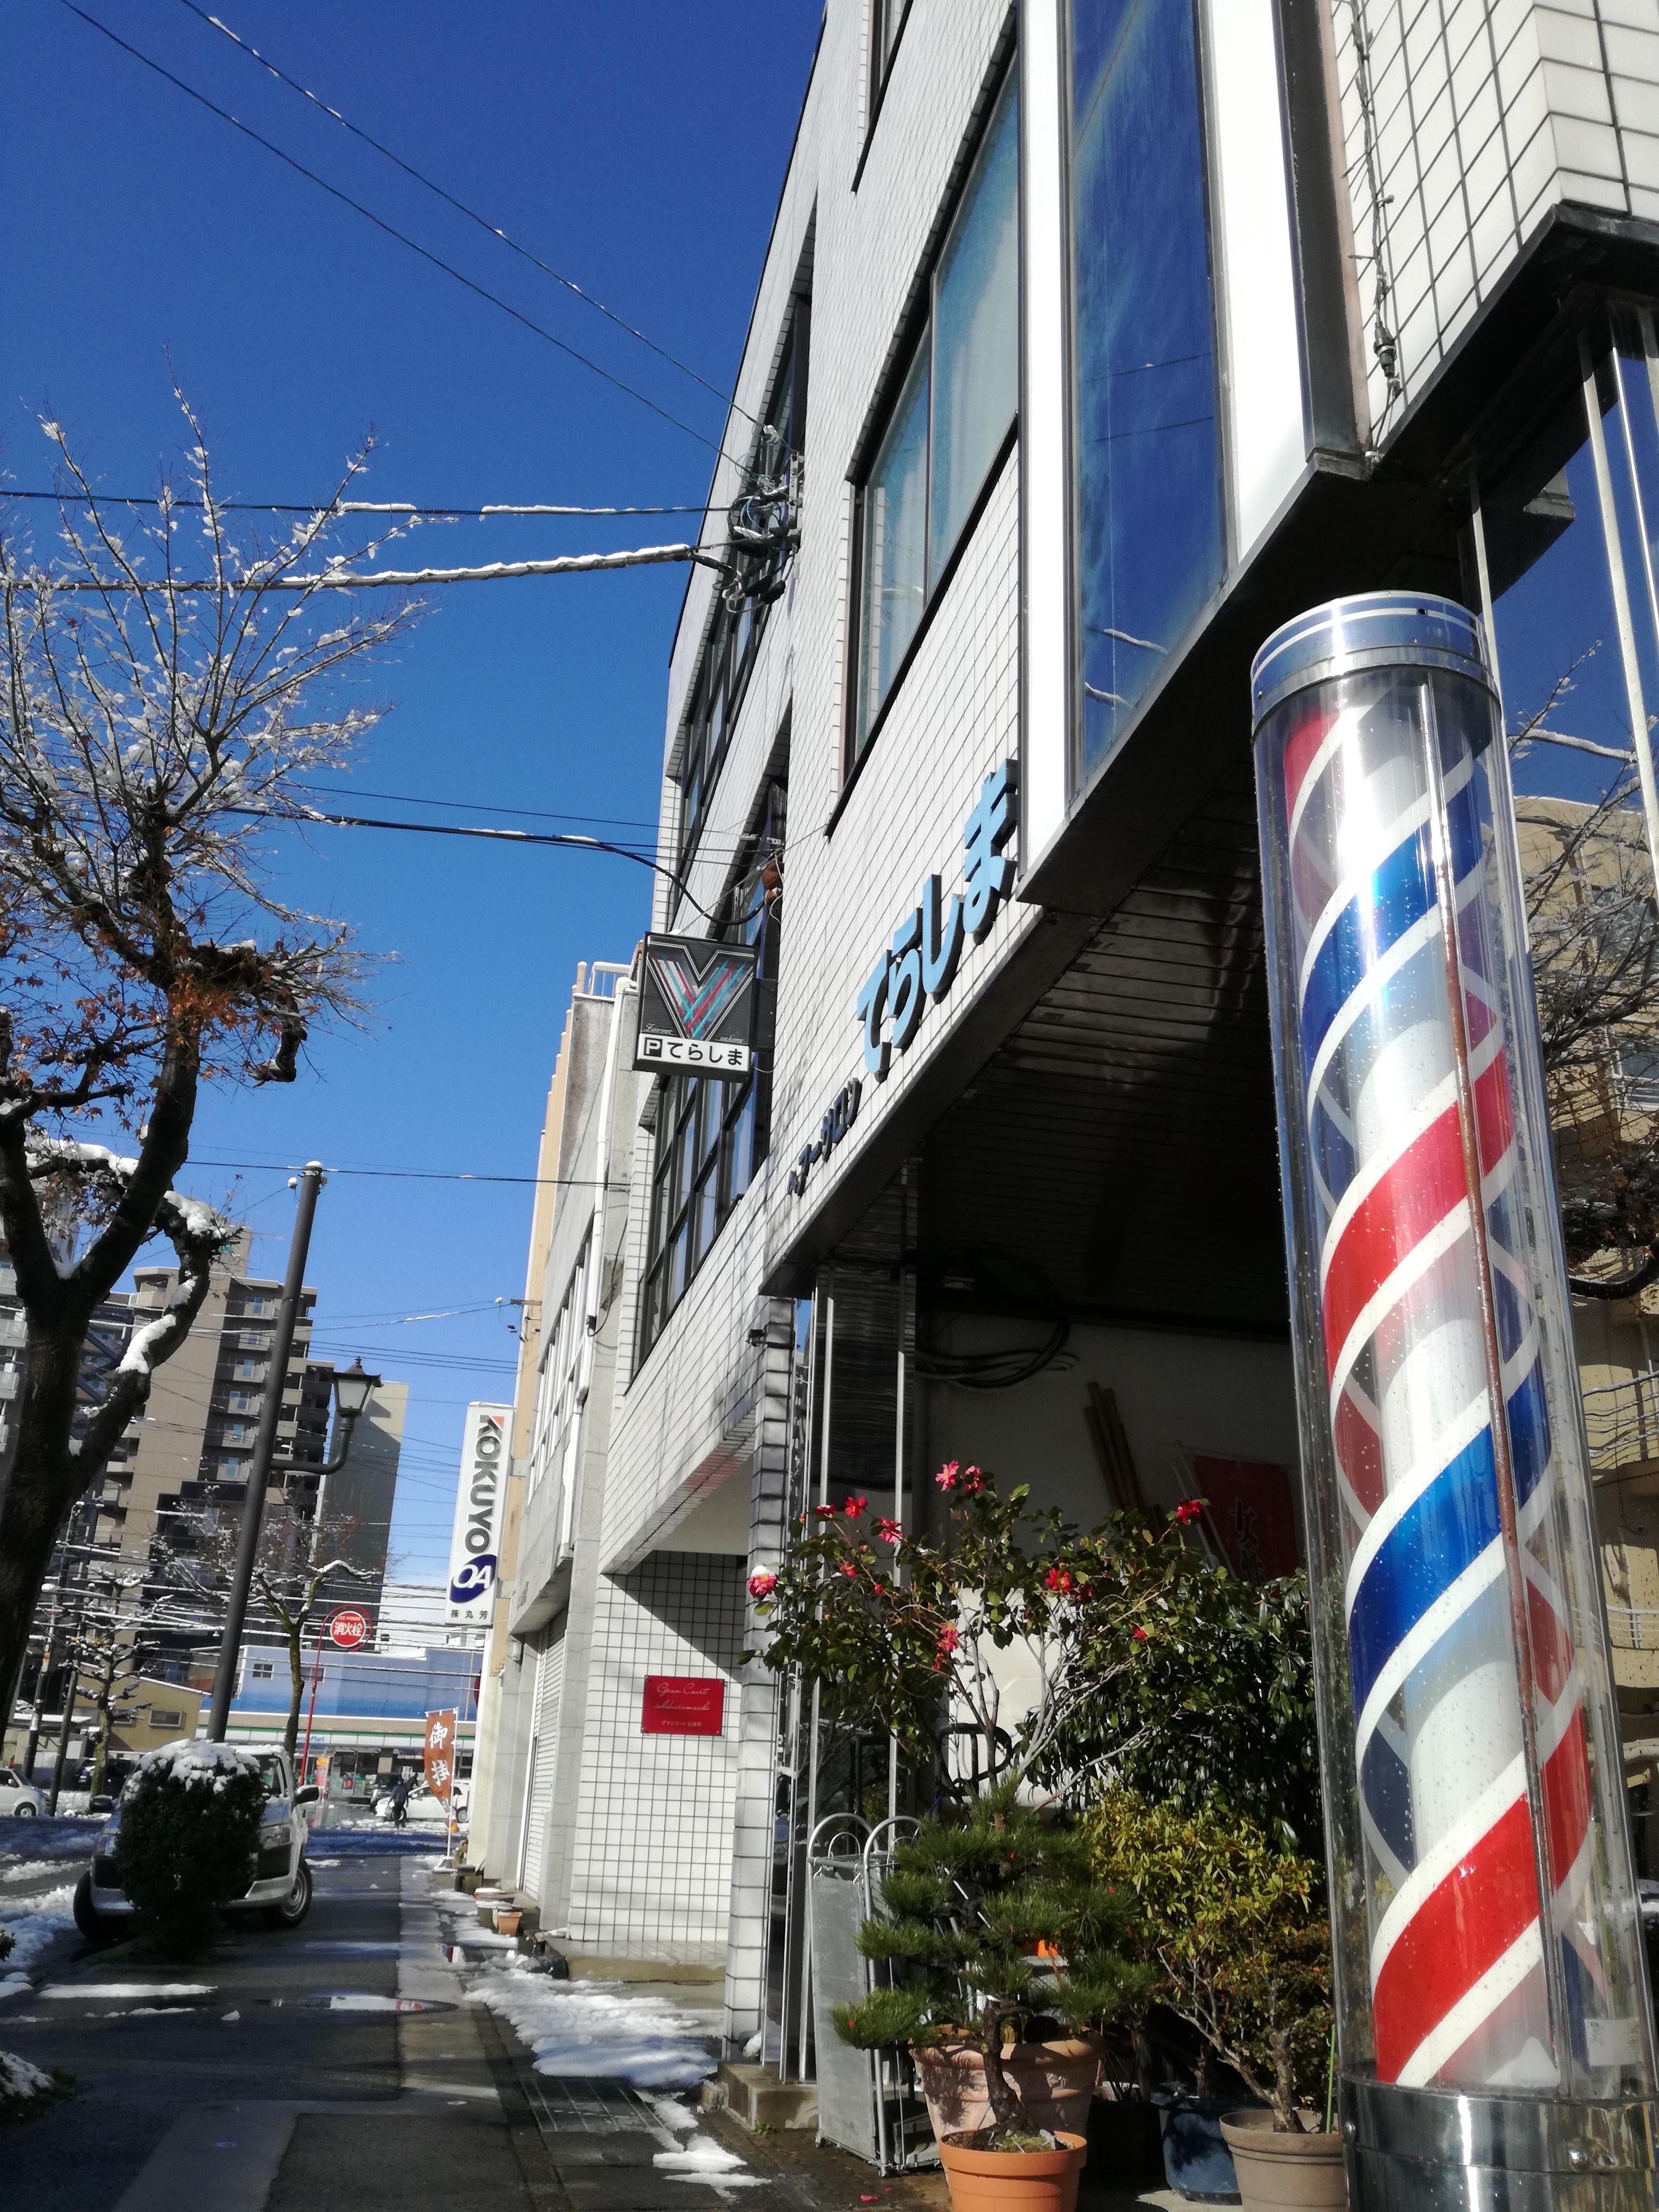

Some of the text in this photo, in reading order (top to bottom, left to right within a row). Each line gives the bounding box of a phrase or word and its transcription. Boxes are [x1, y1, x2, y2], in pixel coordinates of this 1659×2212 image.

[857, 758, 1017, 1084] てらしま
[645, 1038, 743, 1066] P てらしま
[465, 1414, 504, 1554] KOKUYO
[453, 1564, 492, 1589] OA
[333, 1621, 363, 1637] 消火栓
[657, 1682, 710, 1697] Gran Court
